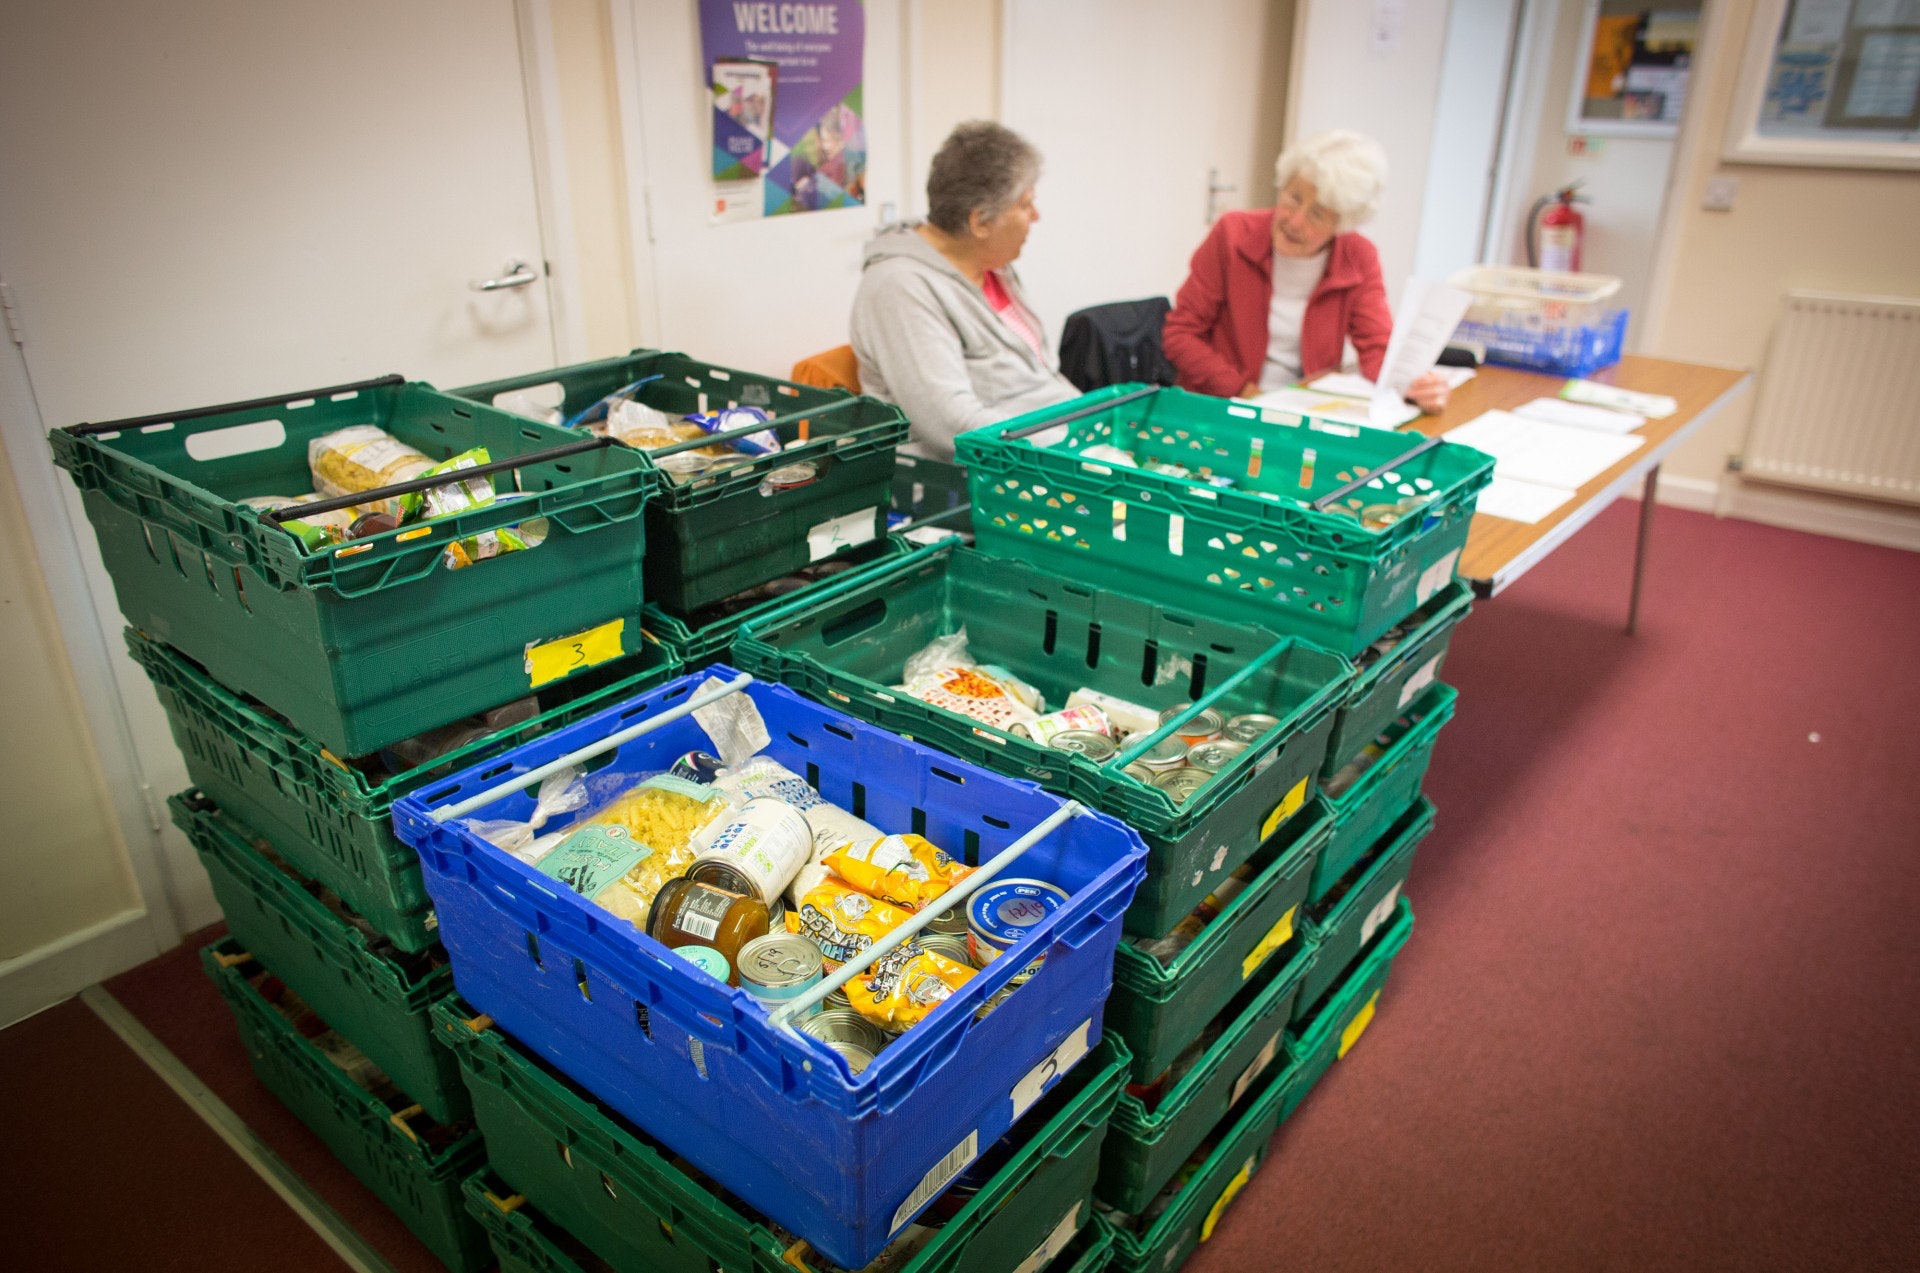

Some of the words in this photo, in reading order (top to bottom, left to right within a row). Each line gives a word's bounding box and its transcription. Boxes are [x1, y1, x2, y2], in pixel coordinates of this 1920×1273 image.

[733, 2, 839, 35] WELCOME
[831, 524, 845, 544] 2
[571, 643, 585, 665] 3
[1017, 888, 1037, 896] PEK
